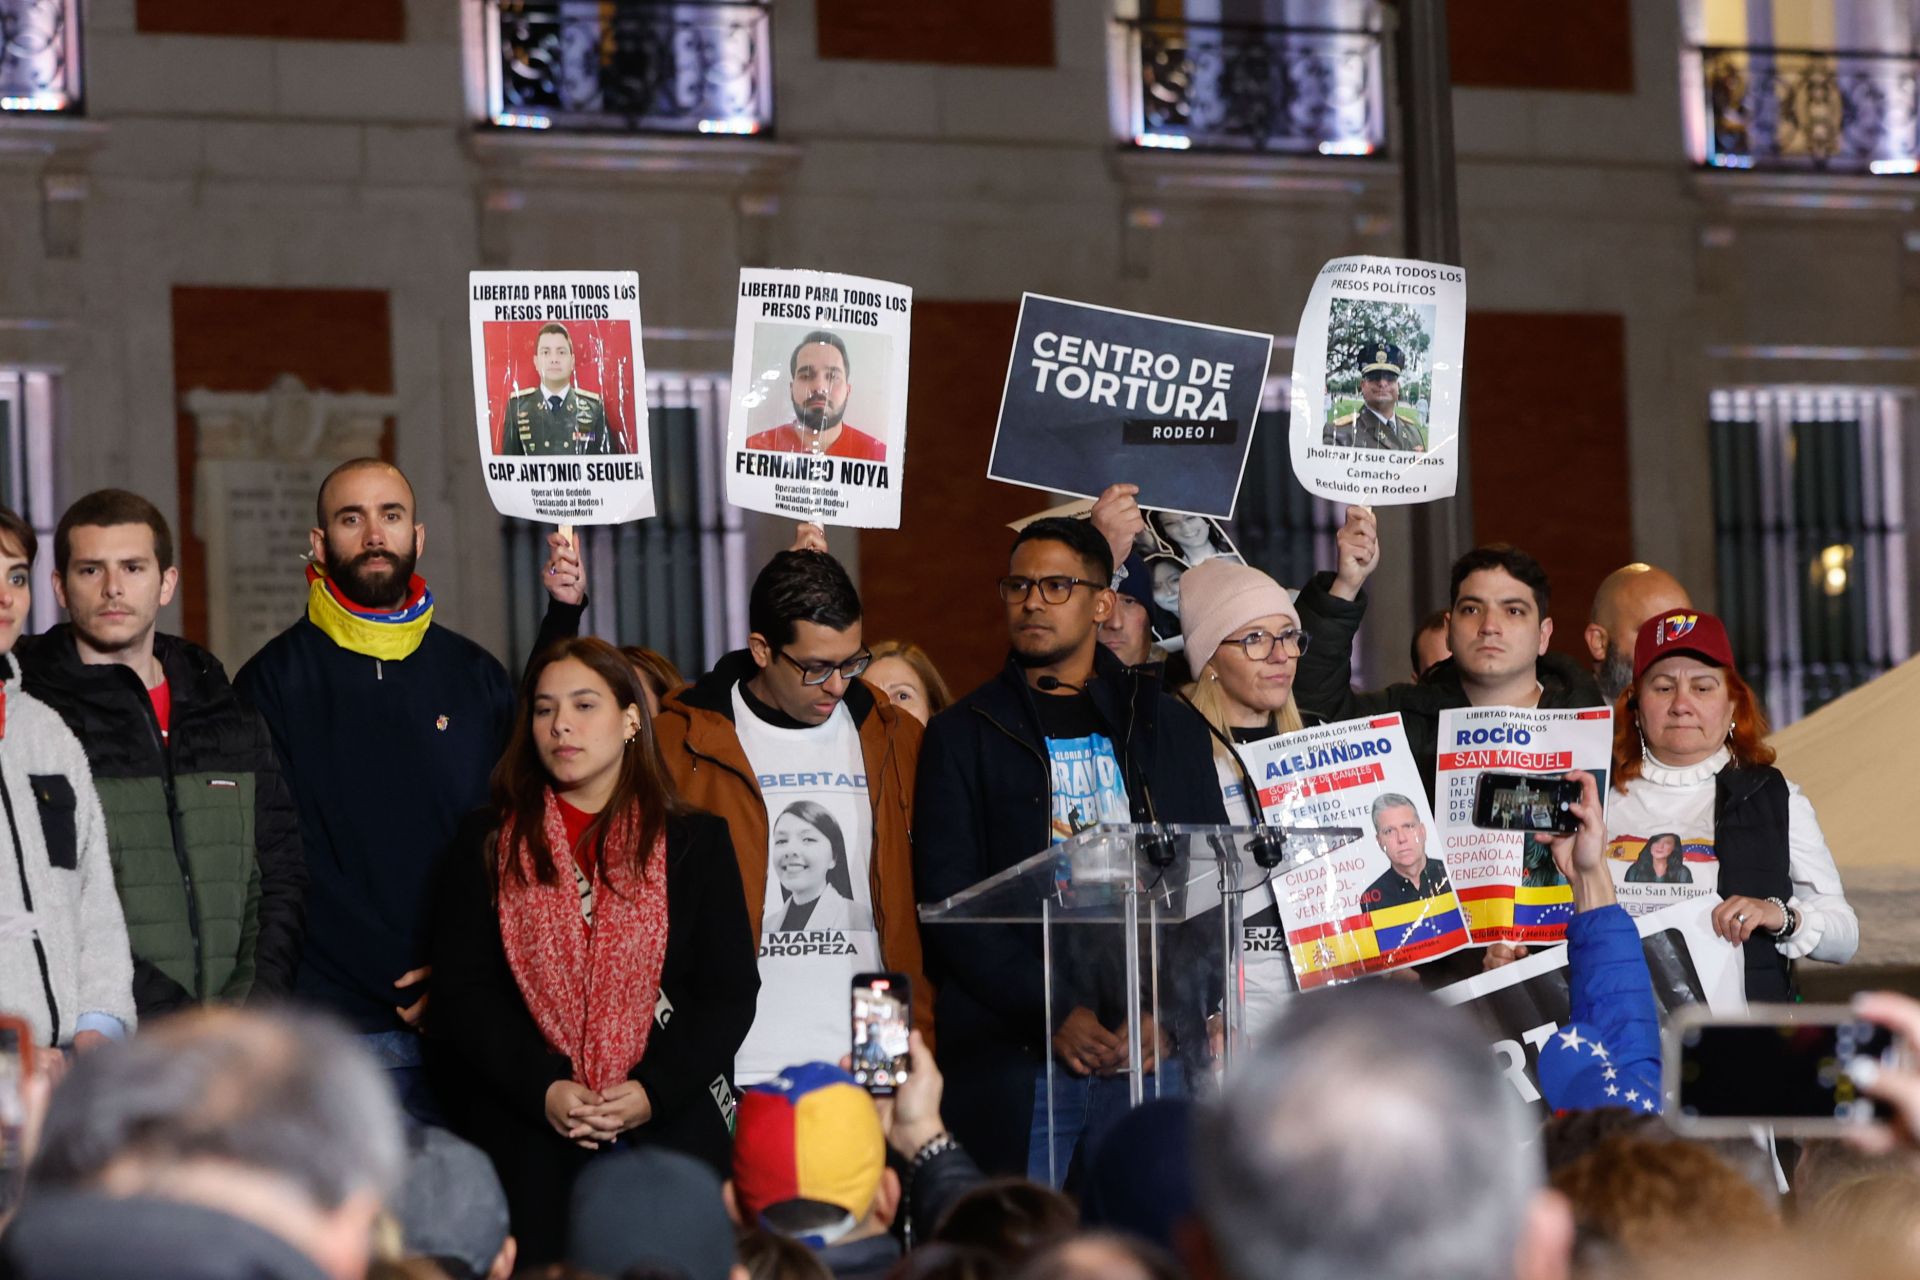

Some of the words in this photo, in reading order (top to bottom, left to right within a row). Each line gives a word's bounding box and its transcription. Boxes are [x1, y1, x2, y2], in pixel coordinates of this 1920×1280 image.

[1322, 263, 1358, 274] LIBERTAD
[1360, 264, 1391, 276] PARA
[1395, 266, 1437, 279] TODOS
[1440, 271, 1462, 283] LOS
[473, 285, 529, 300] LIBERTAD
[534, 285, 567, 300] PARA
[571, 284, 610, 300] TODOS
[614, 284, 636, 300] LOS
[1330, 279, 1369, 291] PRESOS
[1372, 281, 1436, 296] POLÍTICOS
[741, 282, 800, 299] LIBERTAD
[805, 286, 838, 303] PARA
[843, 289, 882, 308] TODOS
[886, 295, 907, 313] LOS
[495, 304, 542, 320] PRESOS
[546, 301, 609, 320] POLÍTICOS
[762, 302, 810, 320] PRESOS
[815, 305, 878, 326] POLÍTICOS
[1033, 331, 1180, 381] CENTRO
[1188, 358, 1235, 390] DE
[1031, 358, 1228, 421] TORTURA
[1152, 426, 1205, 439] RODEO
[587, 462, 644, 481] SEQUEA
[840, 461, 889, 489] NOYA
[1347, 467, 1400, 480] Camacho
[775, 483, 811, 494] Operación
[1315, 478, 1360, 493] Recluido
[1363, 485, 1378, 494] en
[1382, 485, 1420, 494] Rodeo
[570, 498, 576, 506] al
[577, 498, 600, 506] Rodeo
[775, 493, 813, 505] Trasladado
[815, 497, 822, 505] al
[823, 498, 845, 508] Rodeo
[1466, 711, 1507, 720] LIBERTAD
[1509, 712, 1532, 721] PARA
[1534, 713, 1550, 722] LOS
[1553, 712, 1586, 721] PRESOS
[1268, 735, 1309, 751] LIBERTAD
[1310, 730, 1331, 741] PARA
[1333, 725, 1347, 736] LOS
[1456, 727, 1531, 746] ROCIO
[1055, 750, 1082, 760] GLORIA
[1266, 738, 1392, 780] ALEJANDRO
[1454, 750, 1491, 767] SAN
[1496, 749, 1565, 768] MIGUEL
[757, 772, 867, 788] BERTAD
[1273, 799, 1341, 823] DTENIDO
[1446, 832, 1523, 848] CIUDADANA
[1645, 885, 1666, 896] San
[768, 928, 846, 944] MARÍA
